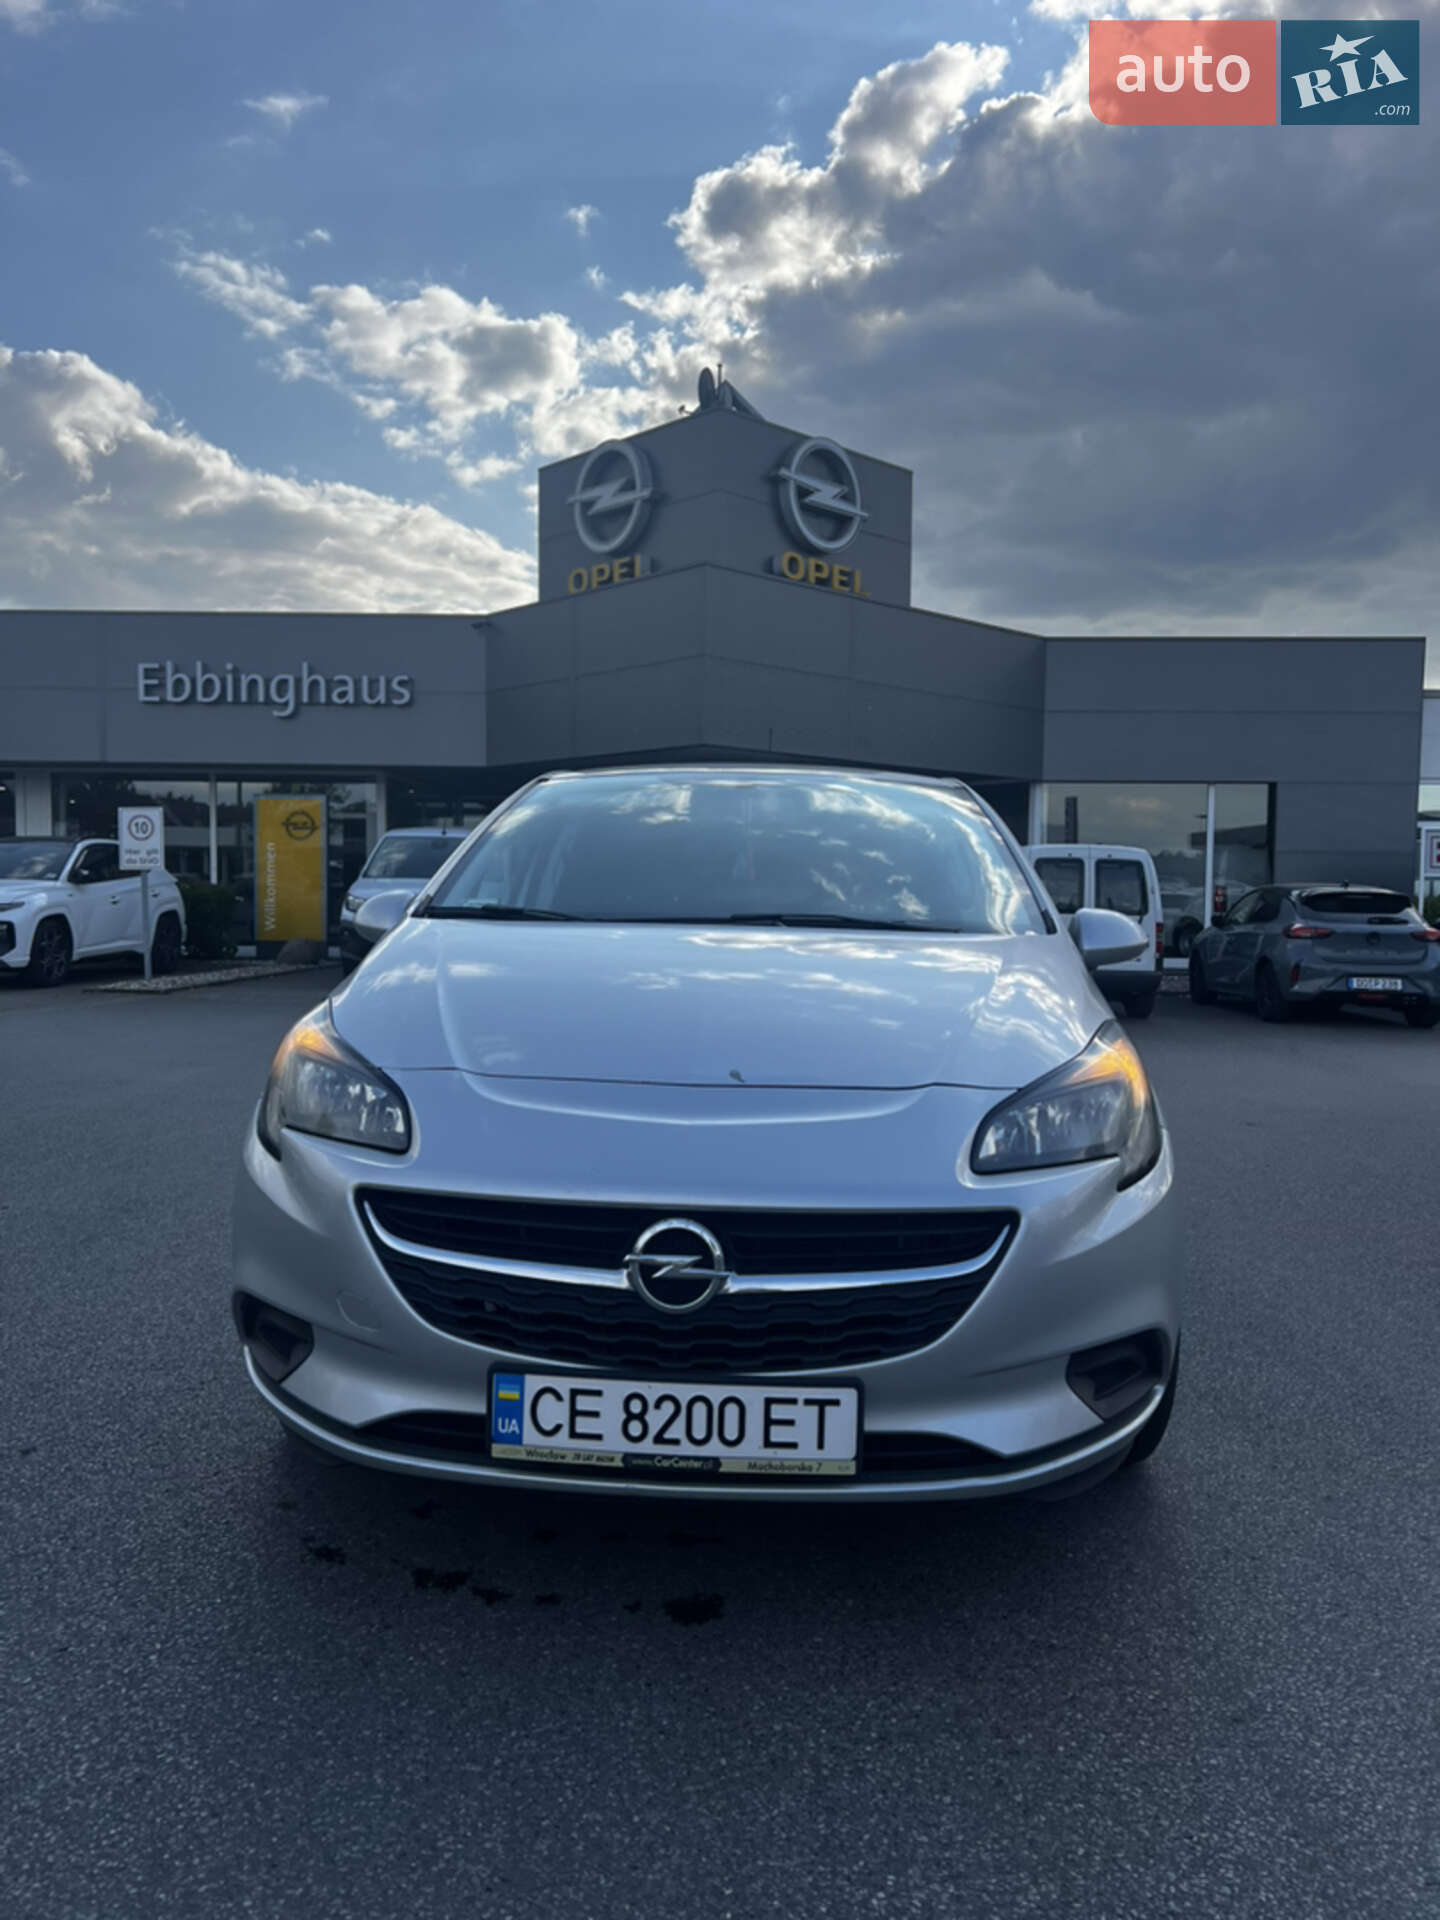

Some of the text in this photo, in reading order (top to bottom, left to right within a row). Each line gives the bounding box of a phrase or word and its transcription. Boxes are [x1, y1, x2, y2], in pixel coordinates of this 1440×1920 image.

[568, 554, 647, 595] OPEL
[781, 550, 870, 598] OPEL
[136, 660, 412, 717] Ebbinghaus
[134, 821, 150, 835] 10
[263, 842, 277, 933] Willkommen
[498, 1386, 841, 1450] UA CE 8200 ET
